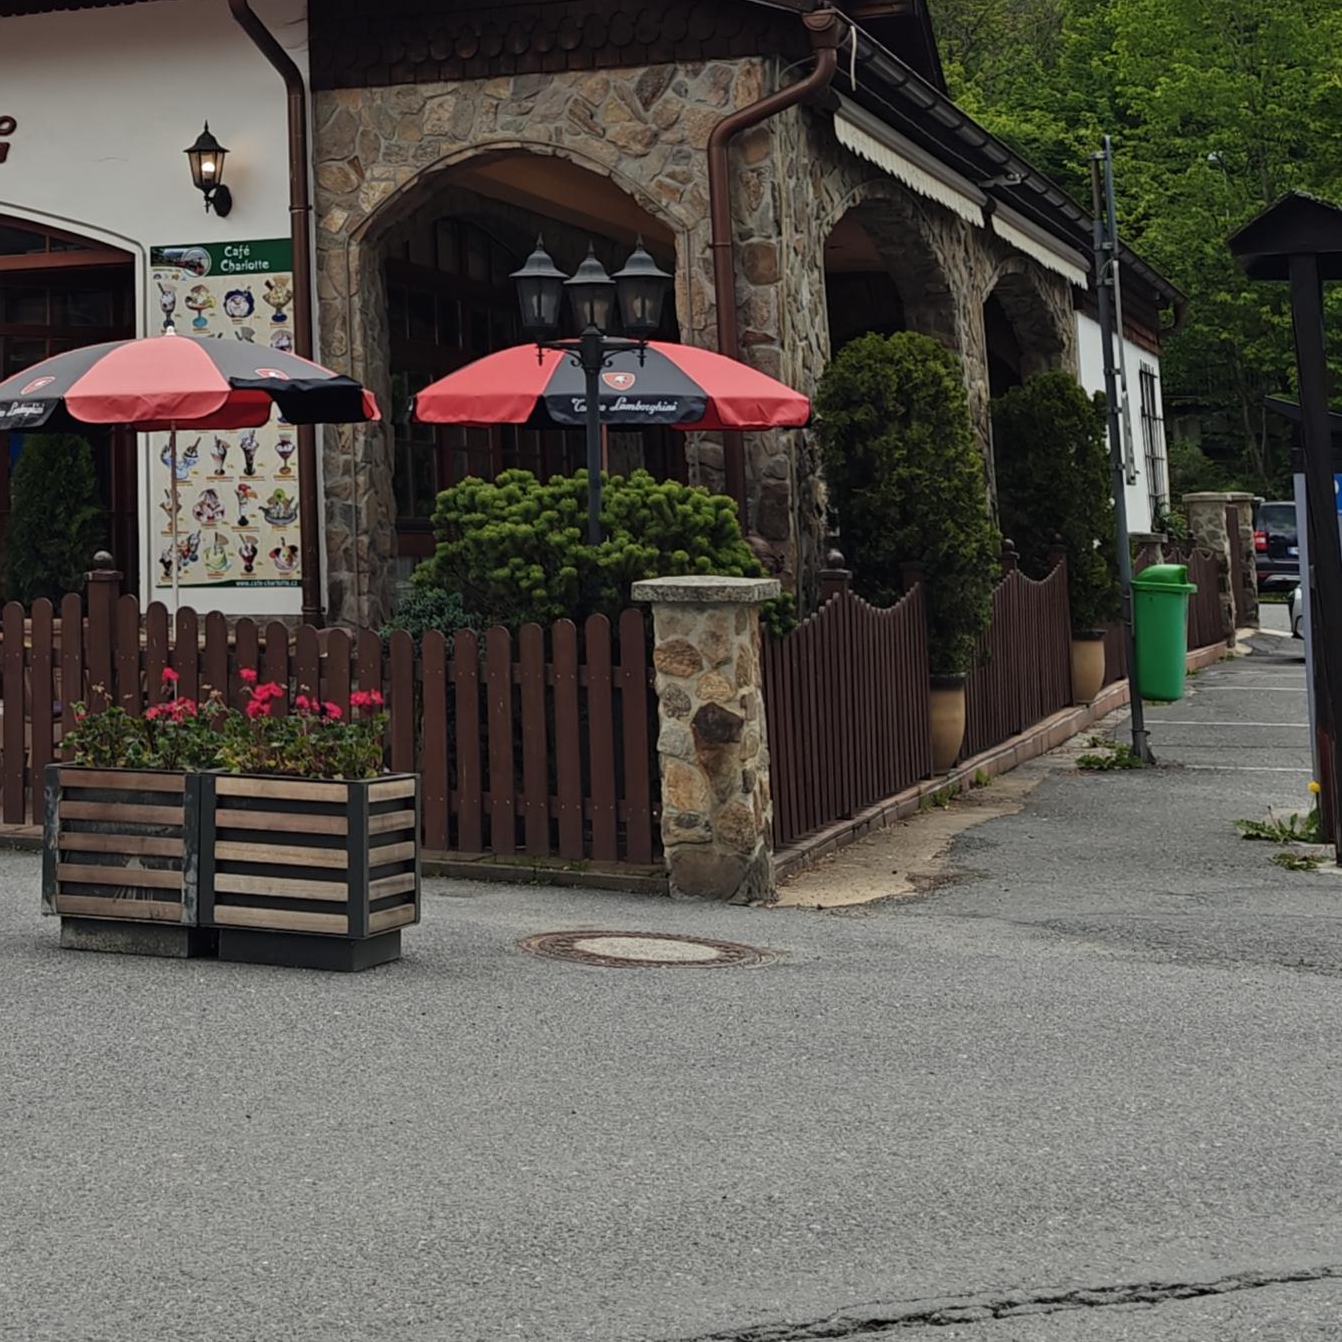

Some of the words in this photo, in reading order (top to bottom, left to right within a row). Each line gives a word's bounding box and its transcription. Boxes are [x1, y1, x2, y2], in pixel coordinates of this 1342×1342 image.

[223, 244, 251, 260] Café
[220, 258, 271, 274] Charlotte
[571, 398, 606, 412] Too
[609, 396, 678, 415] Lamborghini
